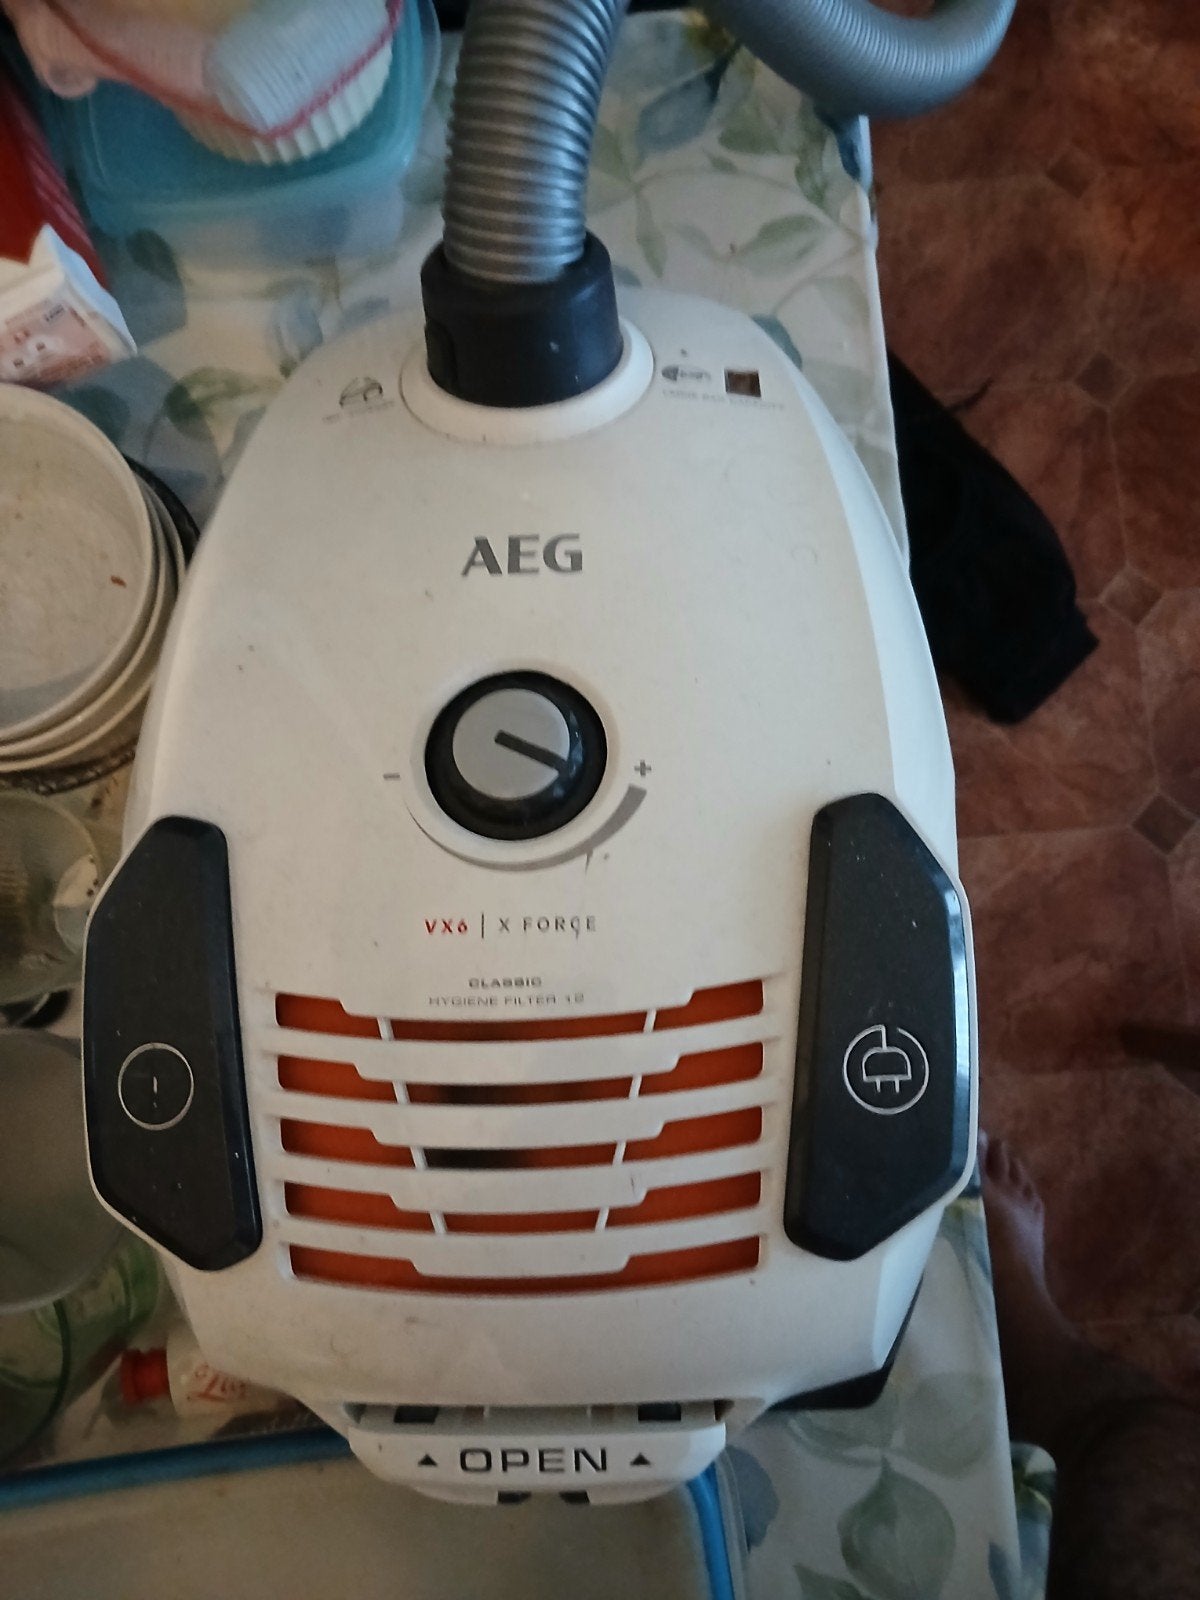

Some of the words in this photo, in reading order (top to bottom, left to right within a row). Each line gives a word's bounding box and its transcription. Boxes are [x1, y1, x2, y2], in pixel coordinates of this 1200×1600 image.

[461, 534, 583, 576] AEG
[425, 918, 468, 934] VX6
[499, 916, 510, 932] X
[523, 915, 597, 932] FORCE
[468, 976, 542, 988] CLASSIC
[429, 996, 498, 1008] HYGIENE
[504, 994, 556, 1005] FILTER
[460, 1448, 607, 1472] OPEN
